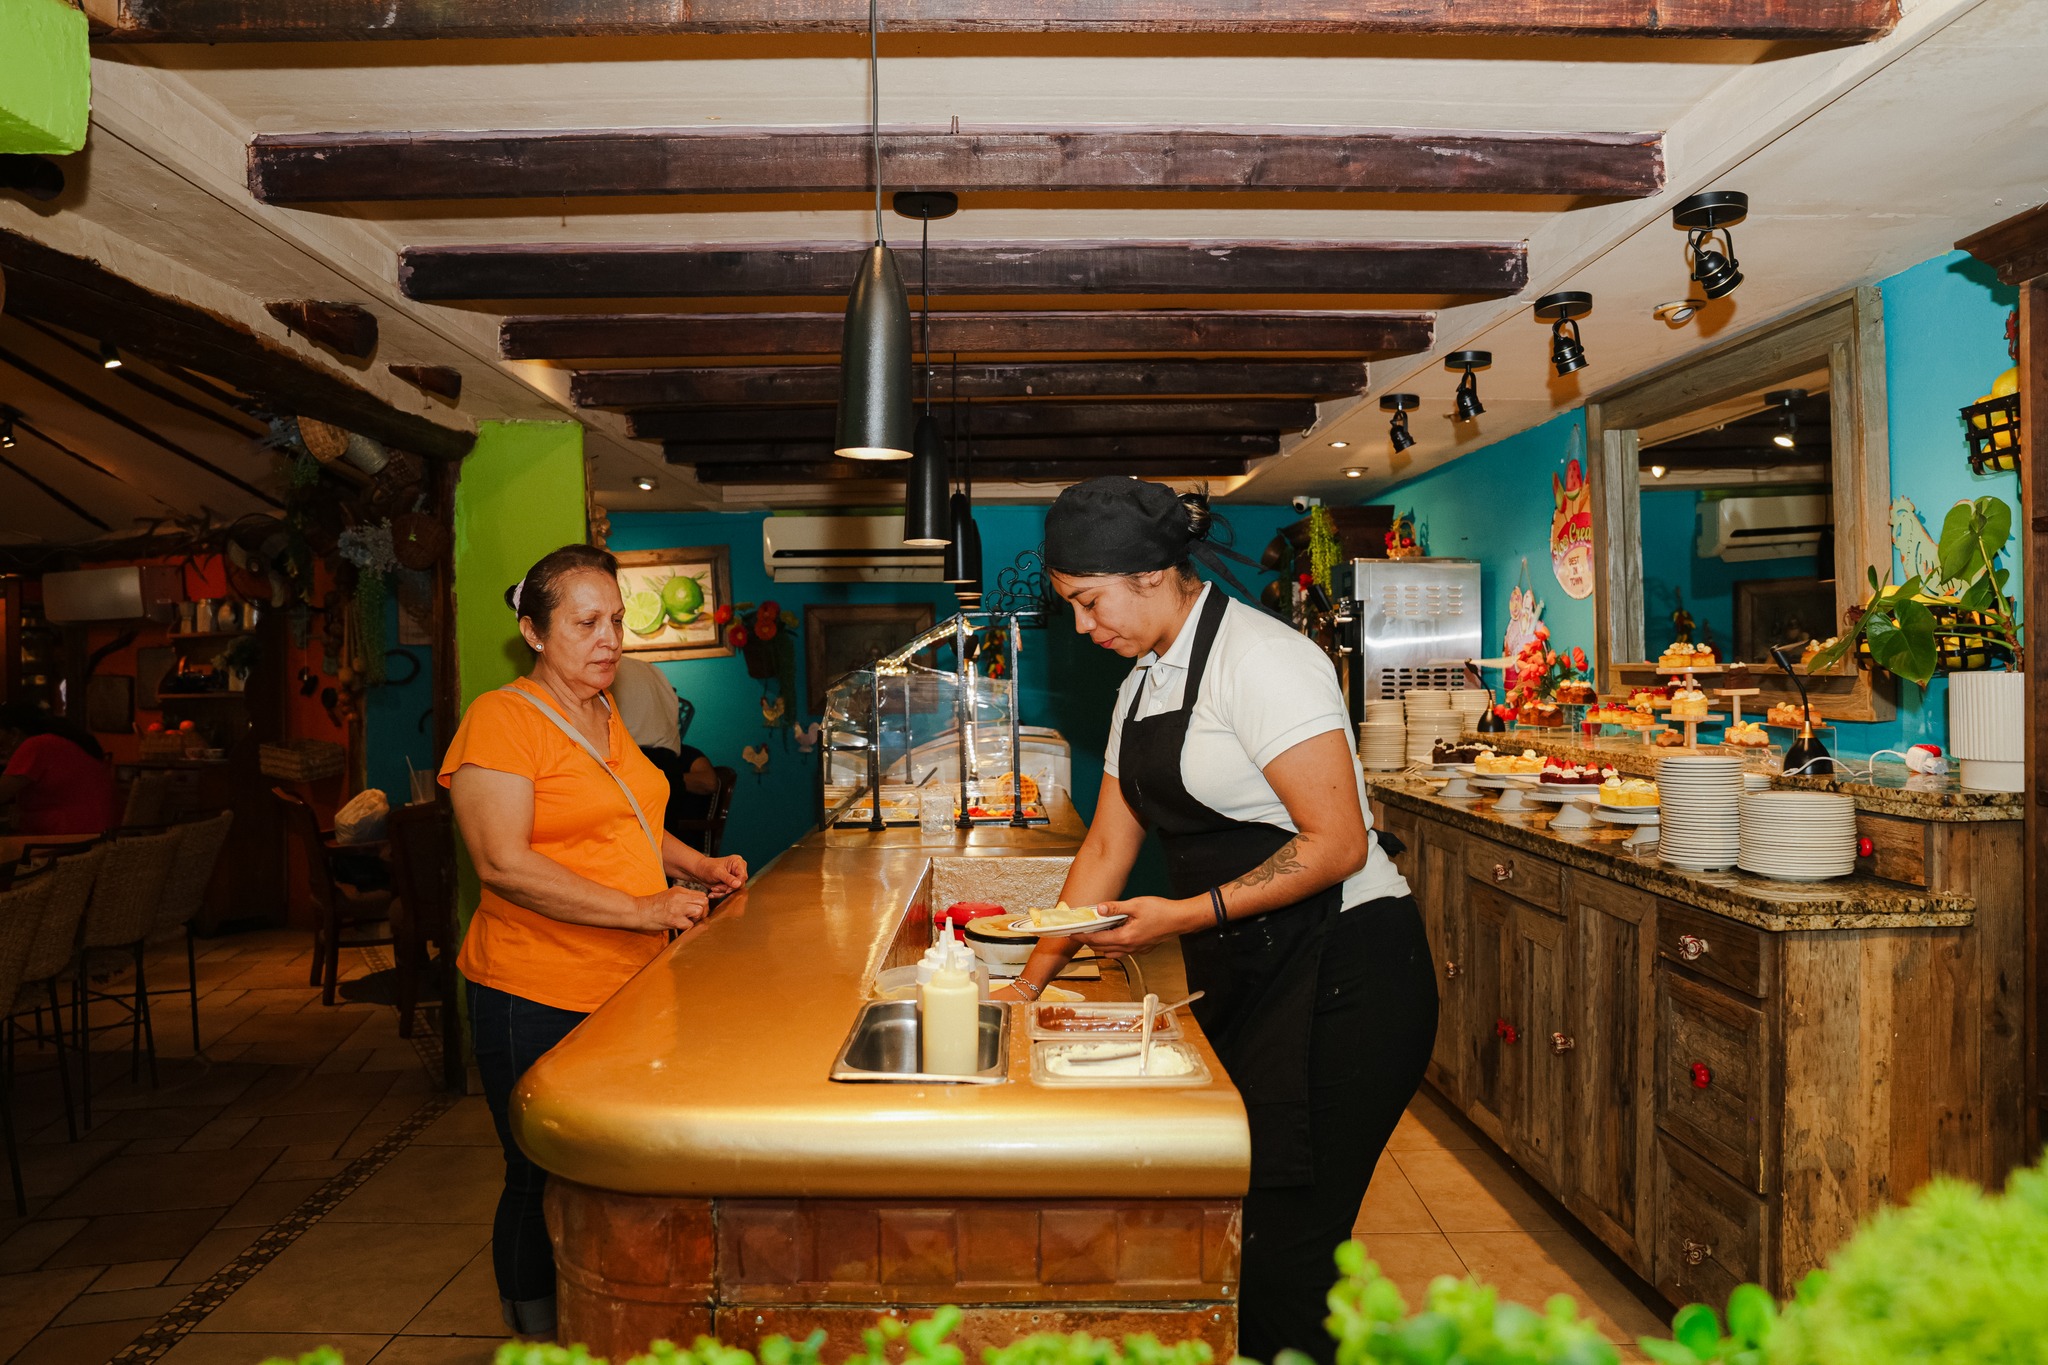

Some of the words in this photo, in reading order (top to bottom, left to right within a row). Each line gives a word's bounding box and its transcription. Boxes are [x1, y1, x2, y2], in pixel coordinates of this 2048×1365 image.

[1569, 523, 1592, 543] Crea
[1568, 556, 1579, 566] BEST
[1570, 577, 1583, 586] TOWN
